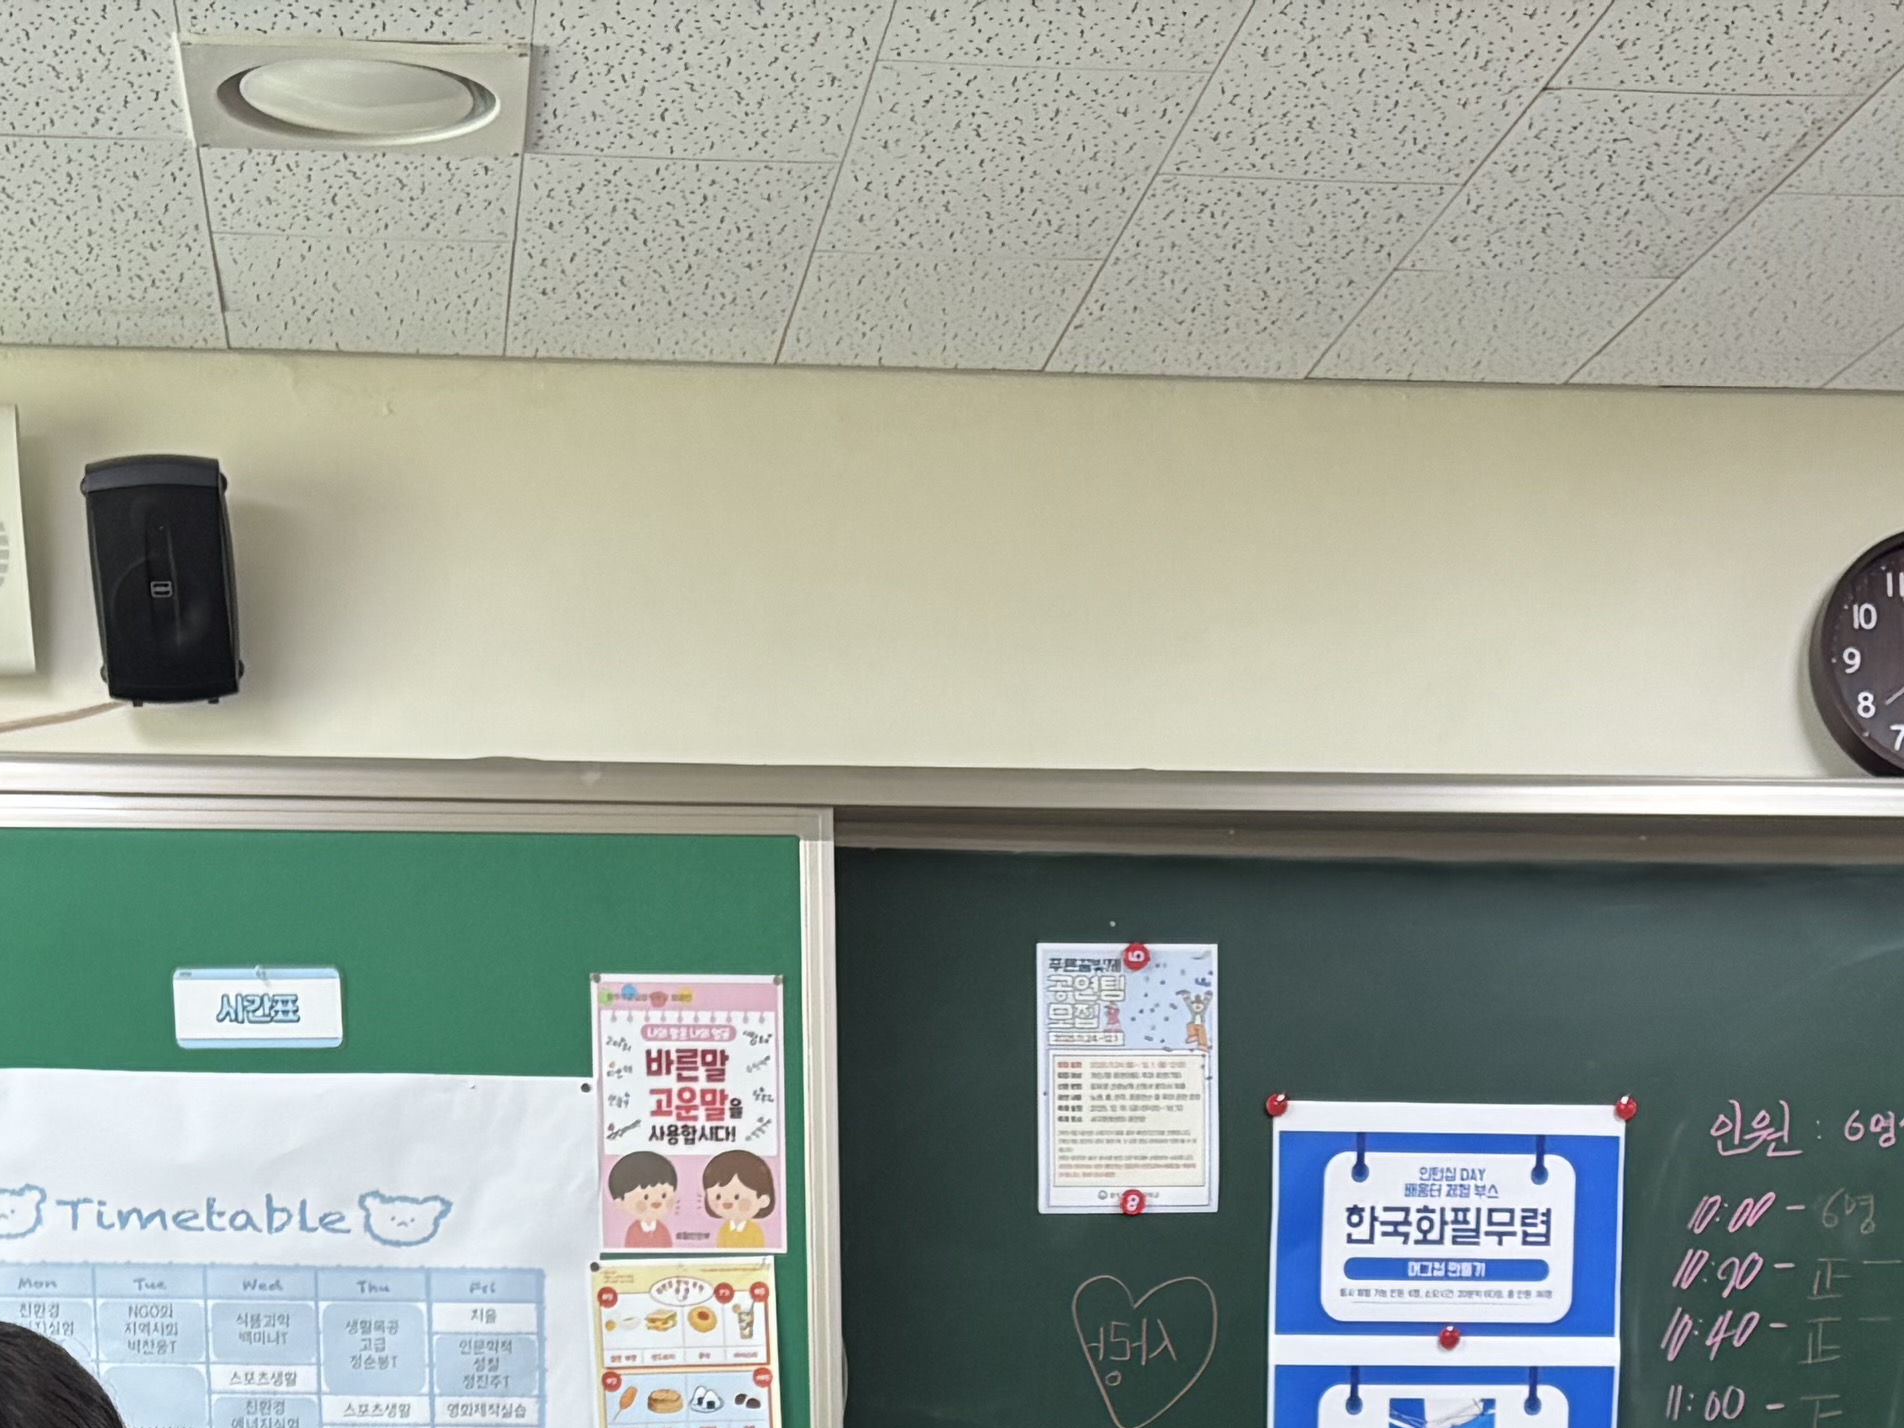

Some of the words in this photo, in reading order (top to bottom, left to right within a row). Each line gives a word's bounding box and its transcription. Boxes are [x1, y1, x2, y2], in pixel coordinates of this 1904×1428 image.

[1853, 603, 1878, 630] 10
[1843, 648, 1861, 674] 9
[1857, 692, 1876, 718] 8
[1048, 975, 1126, 1001] 공연팀
[216, 992, 300, 1025] 시간표
[1048, 1003, 1100, 1029] 모집
[645, 1049, 729, 1083] 바른말
[649, 1086, 743, 1122] 고운말을
[648, 1124, 736, 1146] 사용합시다!
[1710, 1098, 1803, 1158] 인원
[1420, 1167, 1456, 1182] 인턴십
[1460, 1168, 1486, 1181] DAY
[1404, 1183, 1441, 1198] 배움터
[1475, 1184, 1499, 1199] 부스
[56, 1194, 351, 1237] Timetable
[1687, 1191, 1776, 1235] 10:00
[1822, 1187, 1877, 1235] 6명
[1346, 1204, 1551, 1246] 한국화필무렵
[1408, 1261, 1445, 1277] 머그컵
[1448, 1262, 1486, 1277] 만들기
[1673, 1248, 1764, 1299] 10:20
[17, 1276, 58, 1290] Mon
[133, 1277, 167, 1291] Tue
[242, 1279, 283, 1292] Wed
[356, 1279, 390, 1293] Thu
[469, 1280, 496, 1294] Fri
[19, 1304, 60, 1318] 친환경
[237, 1313, 290, 1328] 식품과학
[346, 1319, 399, 1334] 생활목공
[124, 1321, 179, 1337] 지역사회
[1661, 1306, 1760, 1362] 10:40
[360, 1338, 386, 1352] 고급
[459, 1339, 513, 1355] 인문학적
[473, 1357, 499, 1372] 성찰
[230, 1371, 297, 1387] 스포츠생활
[245, 1400, 285, 1415] 친환경
[343, 1403, 411, 1419] 스포츠생활
[447, 1403, 527, 1419] 영화제작실습
[1666, 1384, 1745, 1422] 11:00
